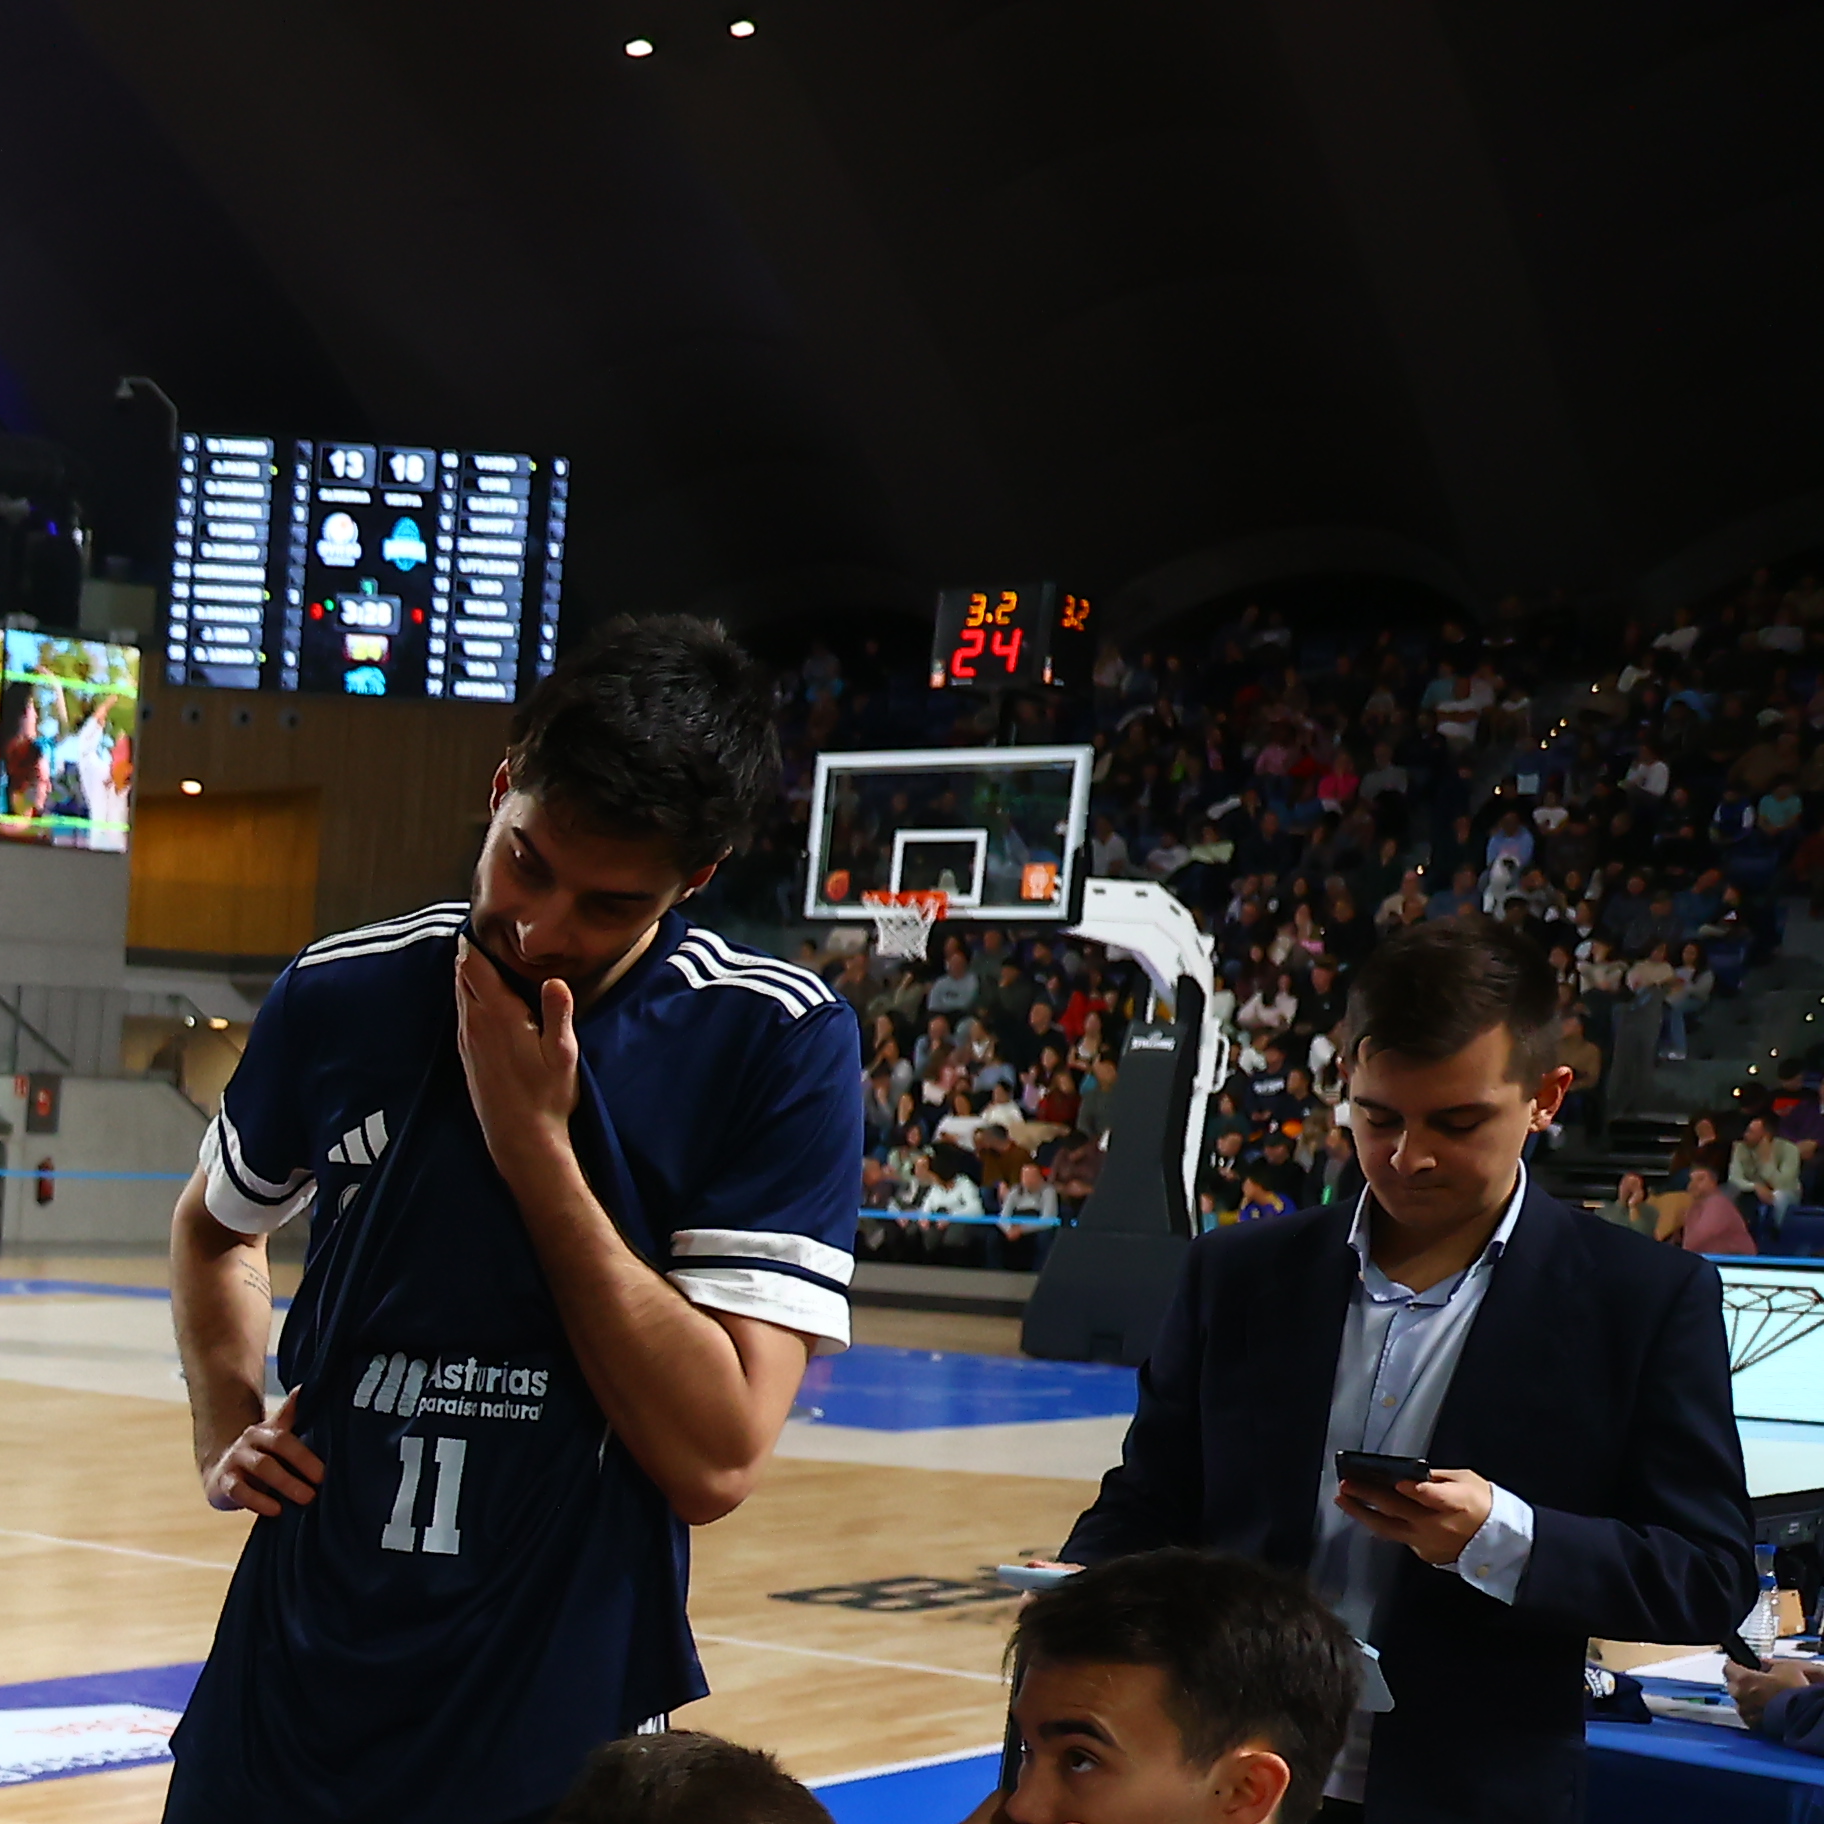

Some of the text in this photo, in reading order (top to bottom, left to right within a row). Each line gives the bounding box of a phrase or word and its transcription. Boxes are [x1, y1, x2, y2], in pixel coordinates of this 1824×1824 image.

[328, 448, 366, 479] 13
[965, 590, 1018, 627] 3.2
[951, 627, 1023, 678] 24
[425, 1355, 549, 1397] Asturias
[380, 1436, 468, 1556] 11
